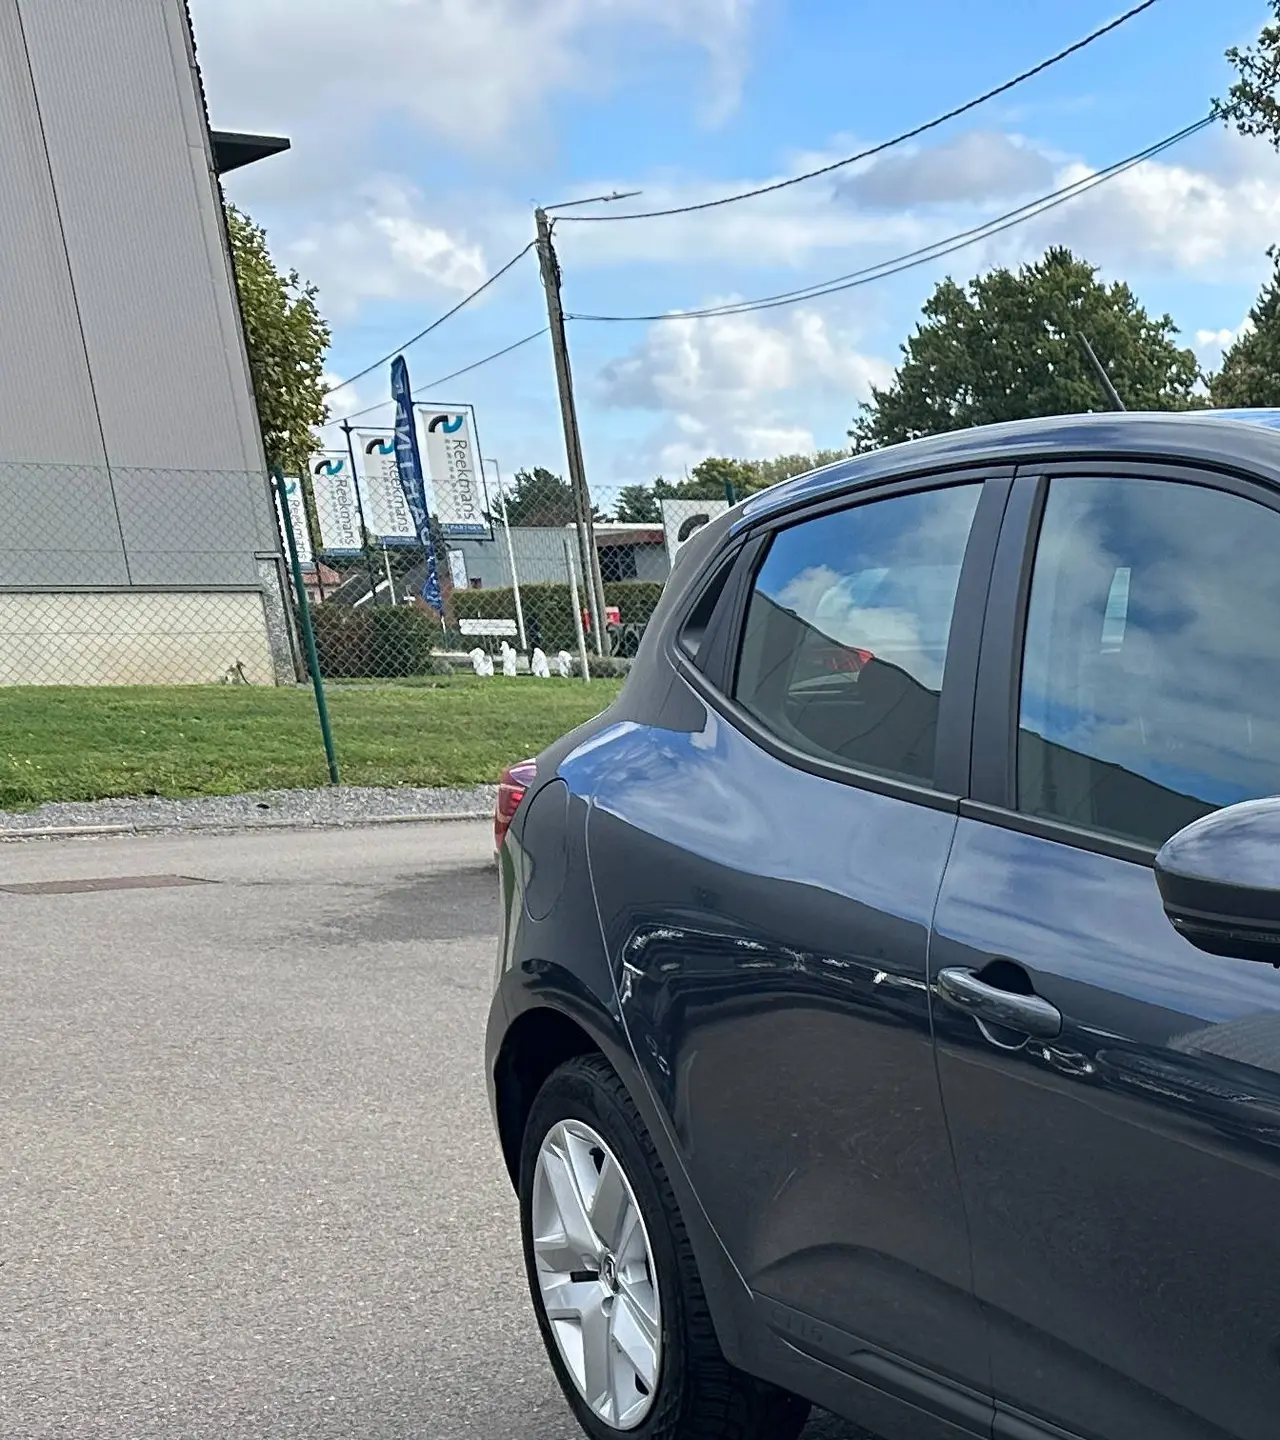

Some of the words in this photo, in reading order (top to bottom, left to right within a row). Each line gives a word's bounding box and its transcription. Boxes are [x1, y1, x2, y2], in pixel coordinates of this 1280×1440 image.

[335, 479, 355, 545] Reekmans
[387, 460, 409, 533] Reekmans
[452, 439, 476, 520] Reekmans
[289, 499, 308, 560] Reekmans
